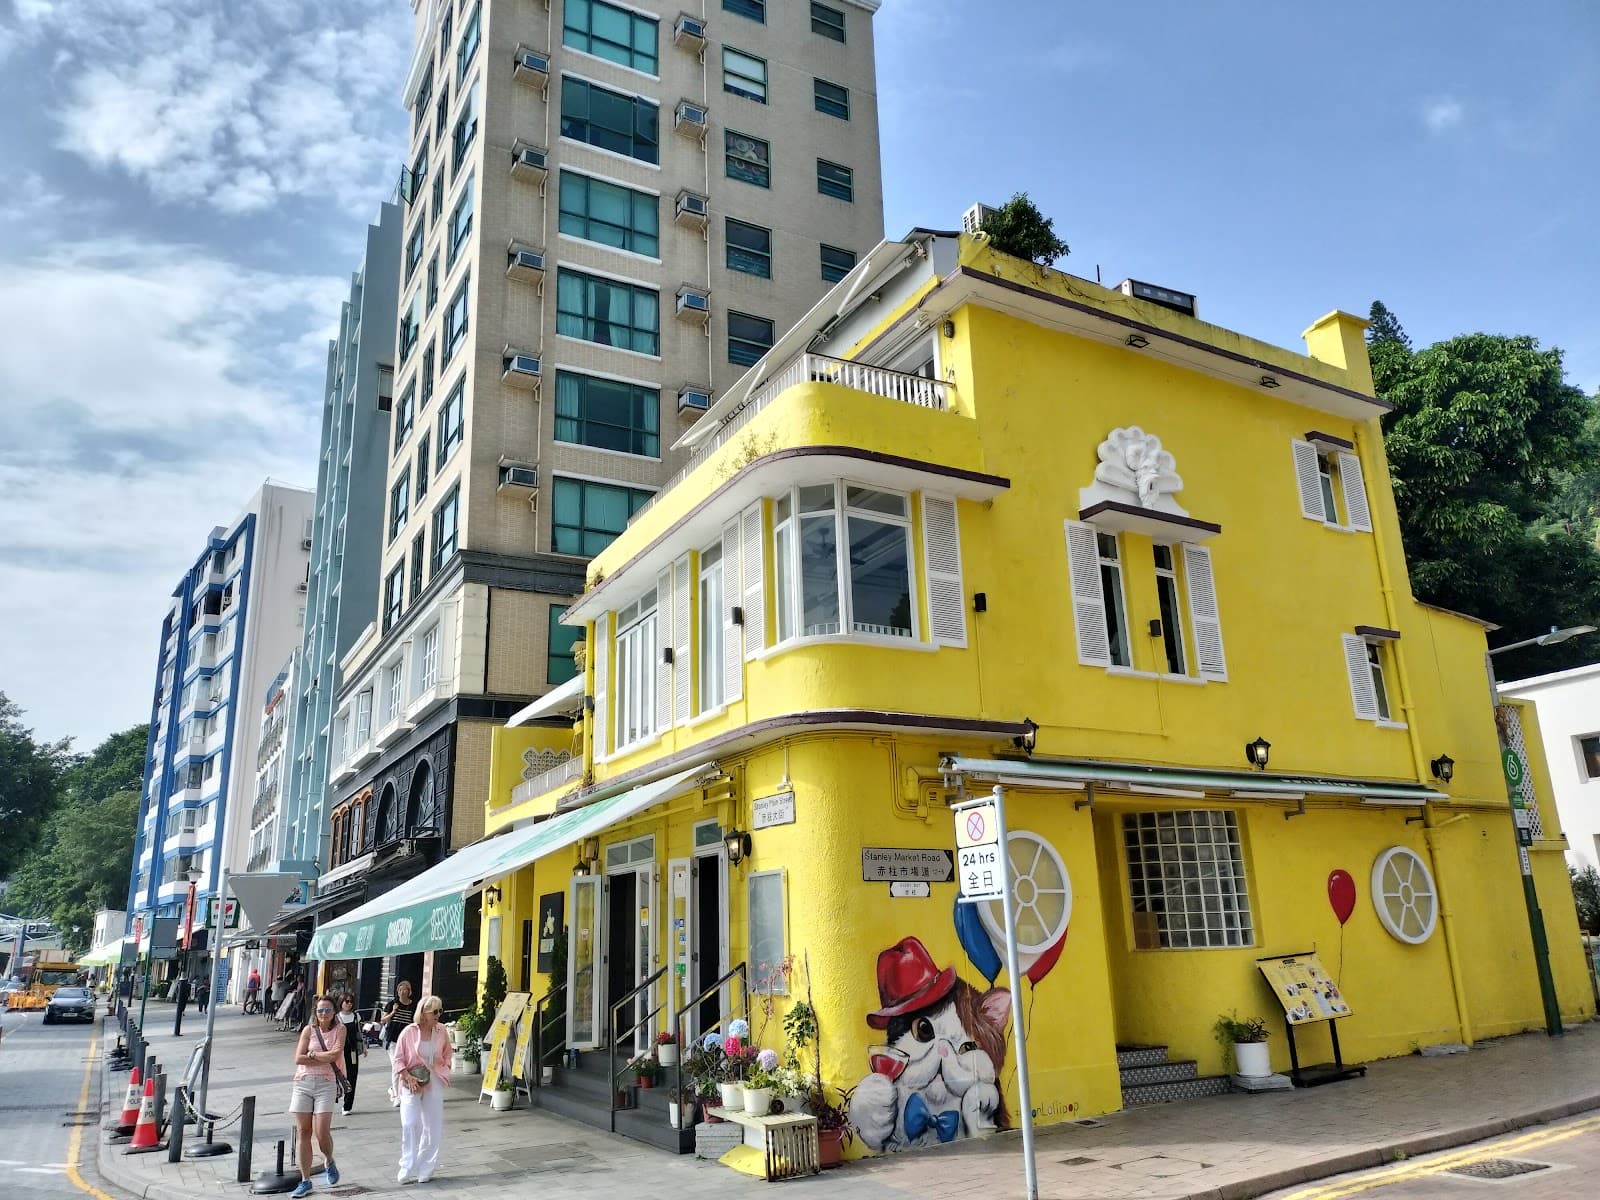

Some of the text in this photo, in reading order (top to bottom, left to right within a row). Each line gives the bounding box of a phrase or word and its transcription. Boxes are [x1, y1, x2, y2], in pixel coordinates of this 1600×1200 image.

[864, 851, 941, 862] Stanley Market Road
[962, 851, 995, 867] 24 hrs
[877, 865, 930, 877] 赤柱市場道
[968, 870, 993, 889] 全日
